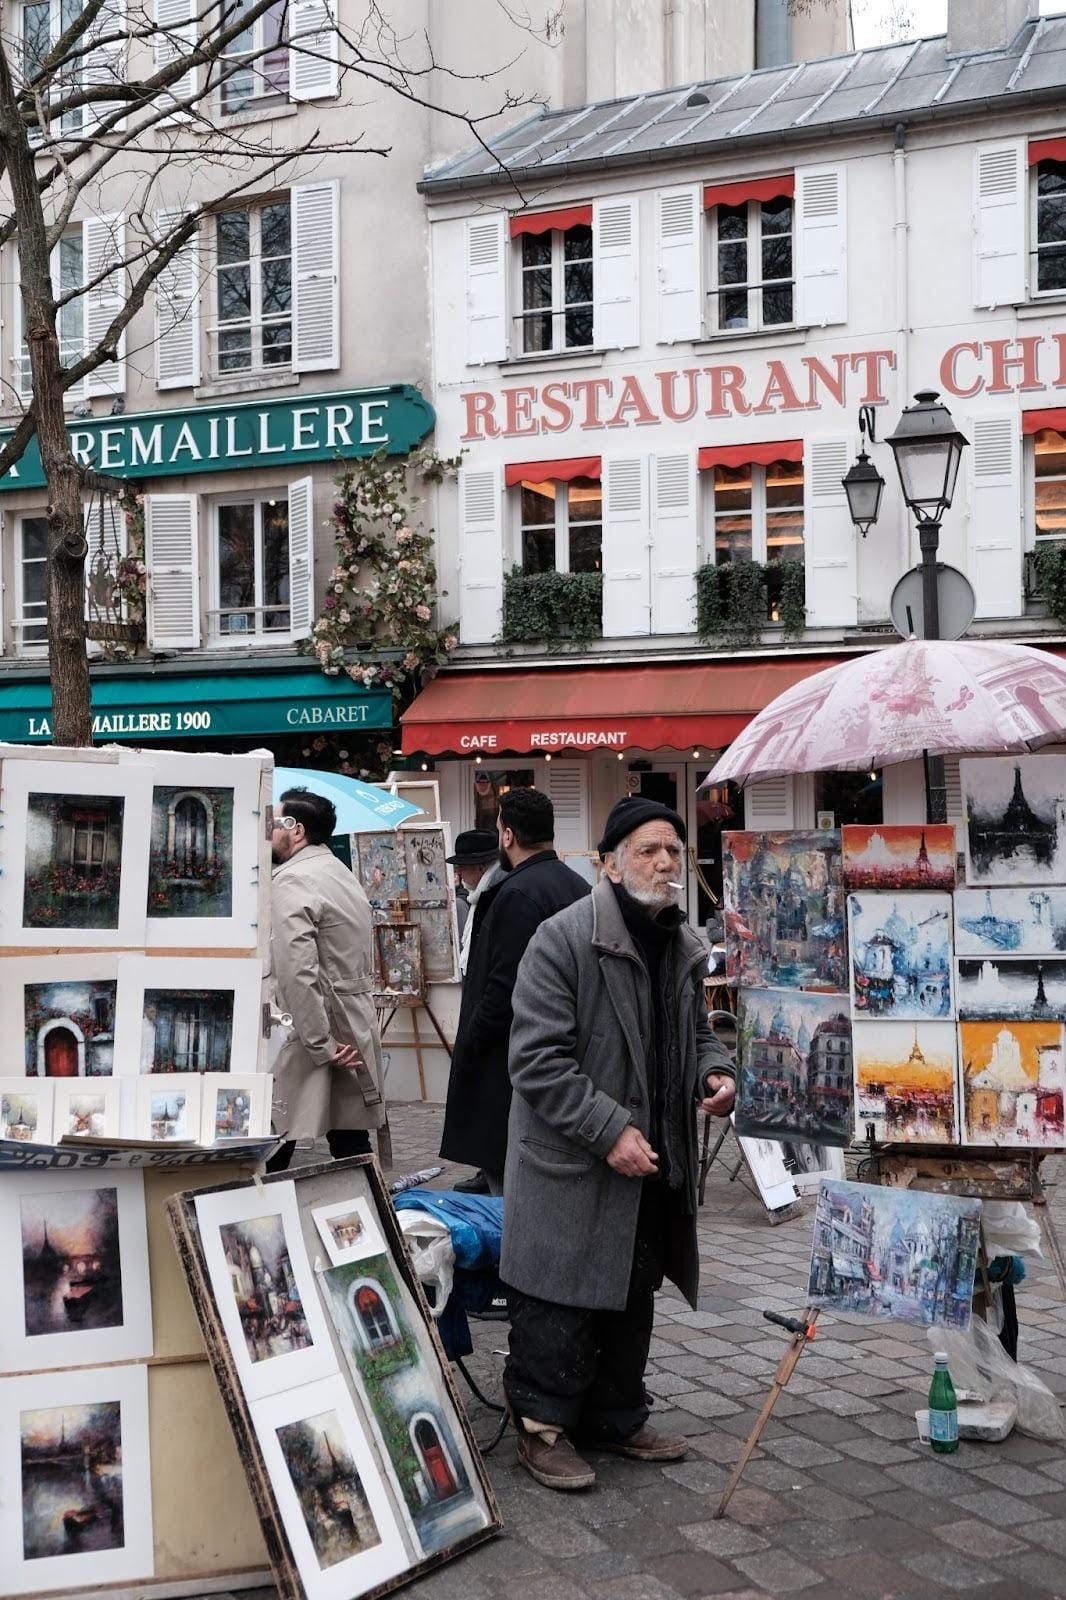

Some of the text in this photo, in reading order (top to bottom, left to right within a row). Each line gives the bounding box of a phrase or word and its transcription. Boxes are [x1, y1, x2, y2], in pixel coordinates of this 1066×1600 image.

[460, 350, 897, 441] RESTAURANT
[70, 400, 390, 470] REMAILLERE
[28, 711, 211, 736] LA MAILLERE 1900
[286, 705, 369, 725] CABARET
[460, 731, 627, 748] CAFE RESTAURANT
